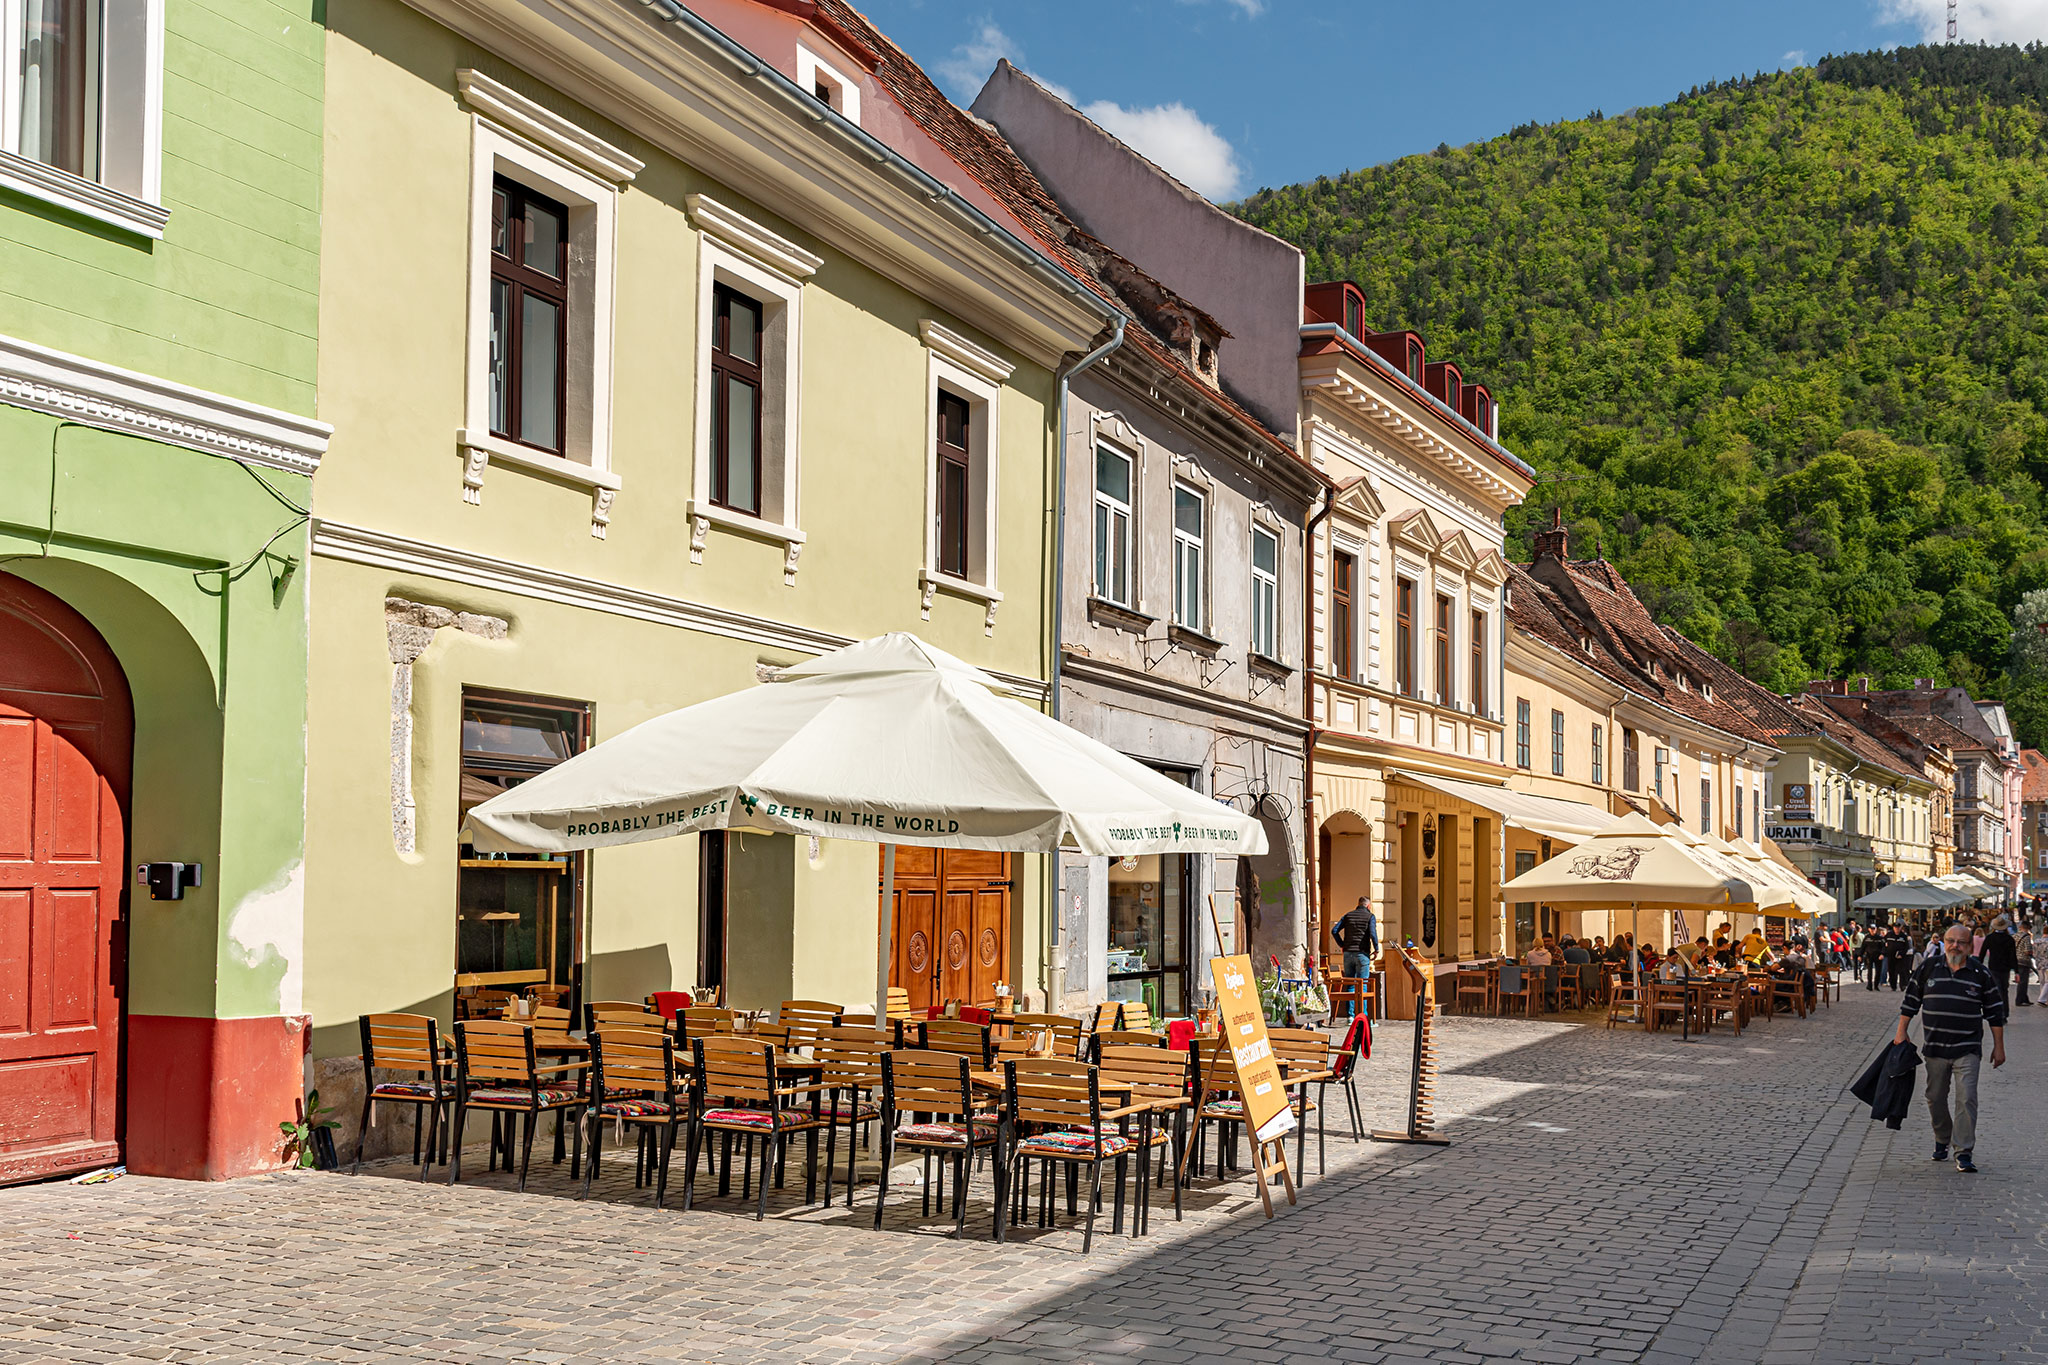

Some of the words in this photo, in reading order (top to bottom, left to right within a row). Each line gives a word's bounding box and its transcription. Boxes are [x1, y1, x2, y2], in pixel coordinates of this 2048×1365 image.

[567, 815, 650, 837] PROBABLY
[656, 809, 685, 826] THE
[692, 799, 728, 819] BEST
[766, 803, 814, 821] BEER
[824, 809, 842, 824] IN
[851, 812, 885, 827] THE
[894, 816, 960, 833] WORLD
[1109, 828, 1144, 840] PROBABLY
[1144, 827, 1159, 840] THE
[1159, 826, 1172, 839] BEST
[1184, 826, 1198, 839] BEER
[1199, 828, 1205, 839] IN
[1206, 828, 1218, 840] THE
[1218, 829, 1239, 841] WORLD
[1766, 827, 1810, 838] URANT
[1233, 1034, 1272, 1069] Restaurant
